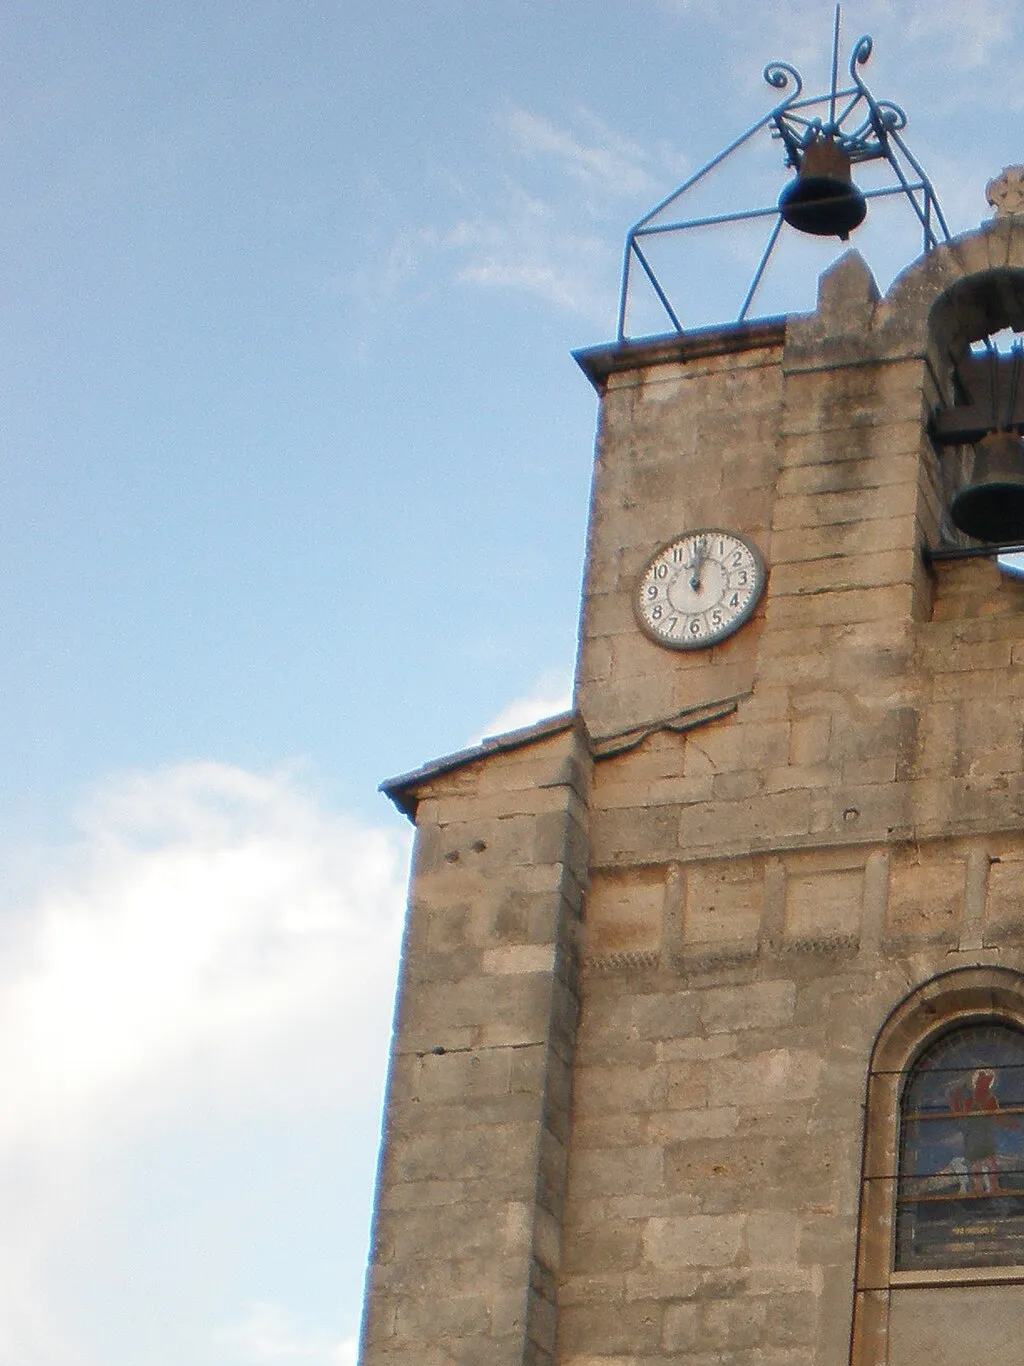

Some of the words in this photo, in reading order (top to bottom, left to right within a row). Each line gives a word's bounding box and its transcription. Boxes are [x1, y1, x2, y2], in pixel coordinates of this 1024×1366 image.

[673, 548, 683, 562] 11
[719, 541, 724, 555] 1
[732, 551, 743, 567] 2
[653, 564, 668, 579] 10
[738, 571, 747, 585] 3
[648, 586, 658, 600] 9
[729, 592, 739, 607] 4
[652, 605, 662, 620] 8
[712, 610, 722, 625] 5
[668, 617, 678, 632] 7
[690, 619, 700, 634] 6
